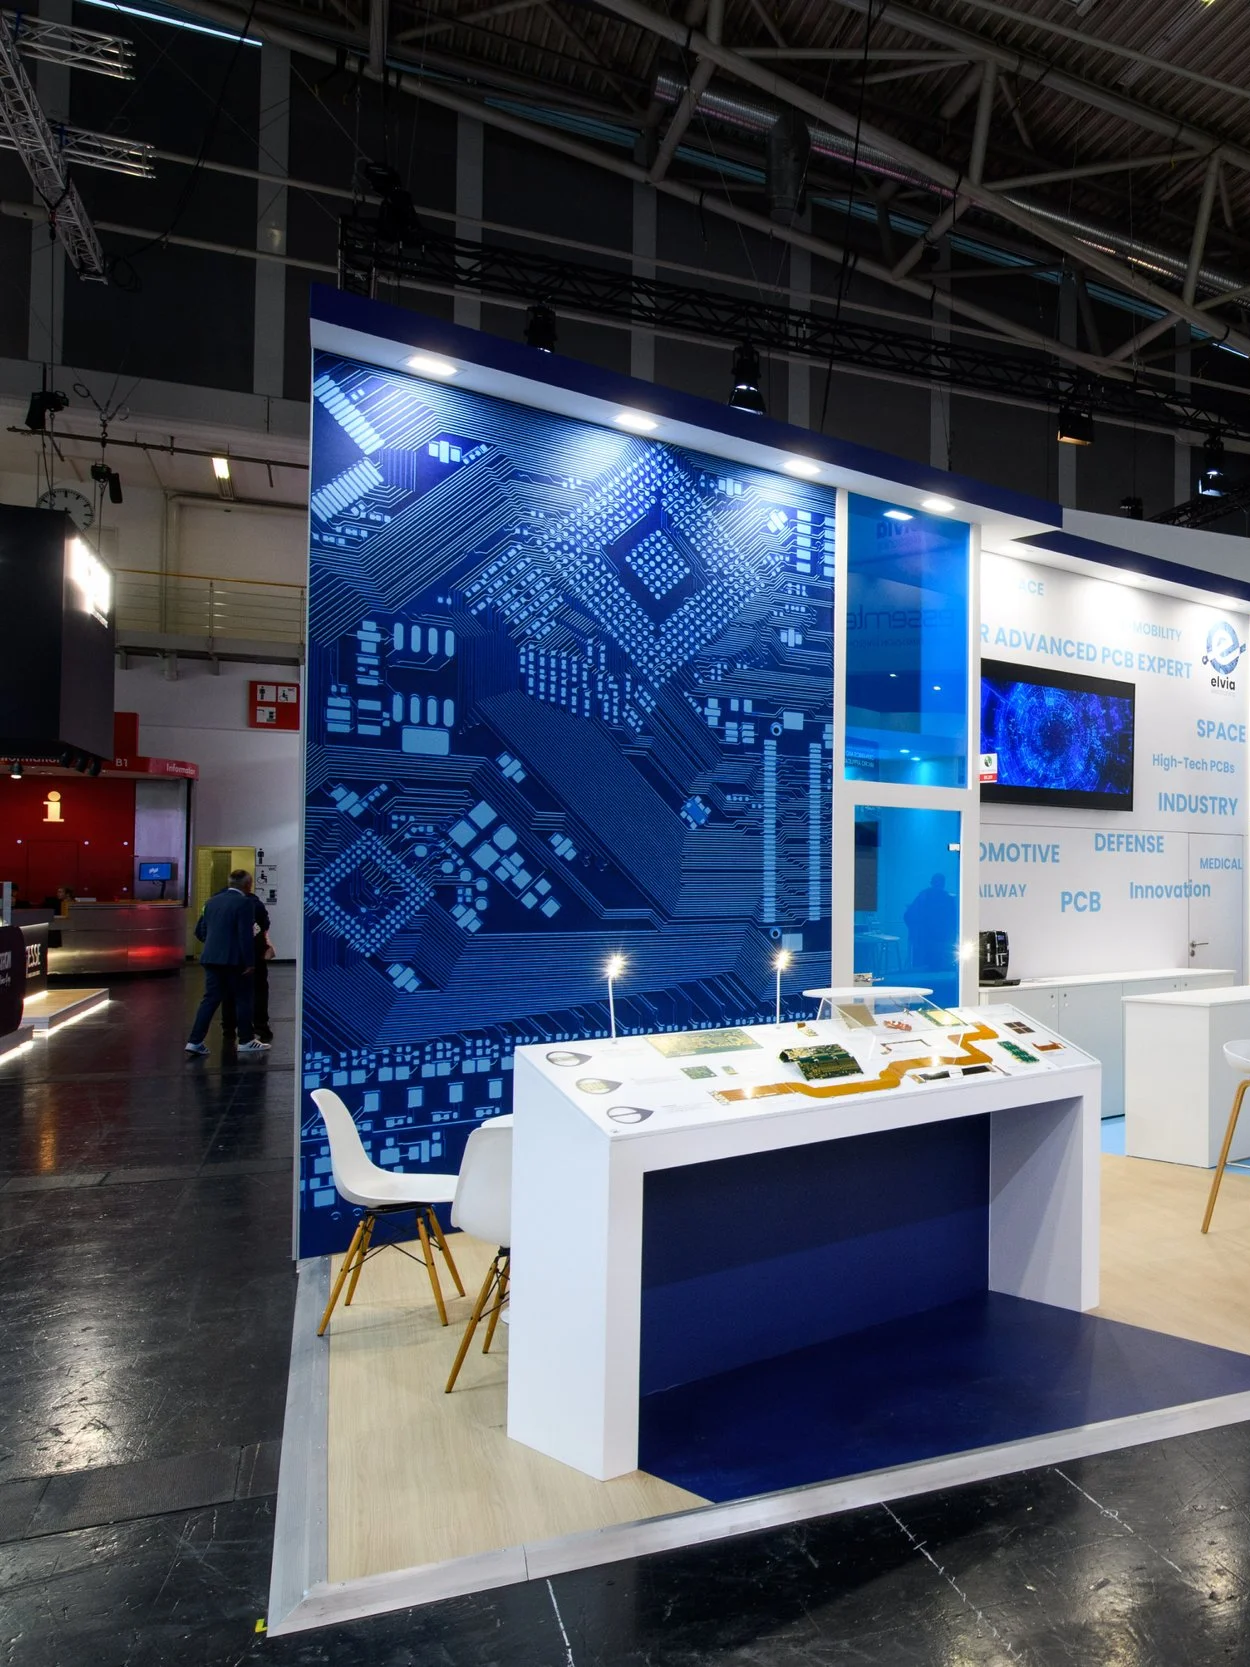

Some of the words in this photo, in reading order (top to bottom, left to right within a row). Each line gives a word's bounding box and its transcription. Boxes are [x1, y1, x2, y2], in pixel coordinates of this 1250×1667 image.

[995, 628, 1097, 661] ADVANCED
[1102, 650, 1133, 669] PCB
[1138, 653, 1192, 679] EXPERT
[1211, 676, 1235, 691] elvia
[1197, 719, 1246, 743] SPACE
[115, 758, 128, 767] B1
[1152, 753, 1207, 772] High-Tech
[1210, 760, 1235, 774] PCBs
[1158, 792, 1238, 816] INDUSTRY
[1095, 833, 1164, 853] DEFENSE
[1200, 857, 1243, 870] MEDICAL
[1130, 879, 1211, 899] Innovation
[1061, 890, 1101, 913] PCB
